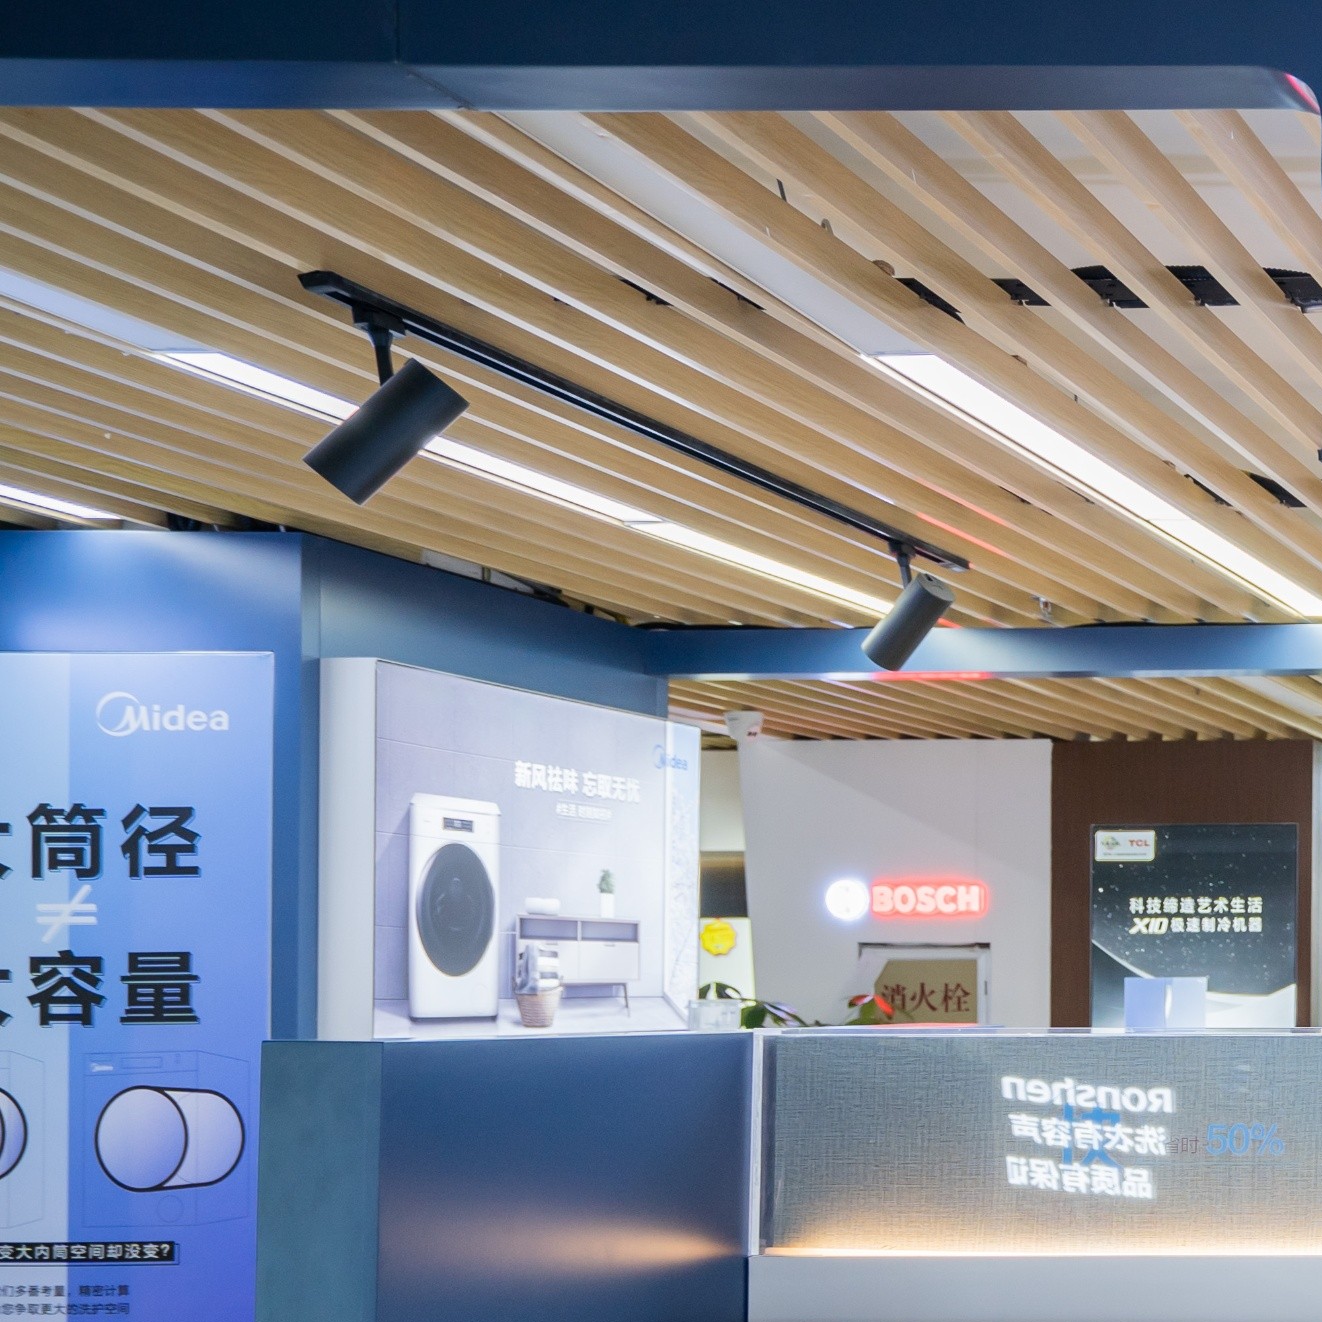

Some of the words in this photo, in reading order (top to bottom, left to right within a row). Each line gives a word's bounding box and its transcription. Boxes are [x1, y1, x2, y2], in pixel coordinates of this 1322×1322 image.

[95, 691, 229, 736] Midea
[0, 803, 202, 881] 筒径
[1128, 839, 1150, 848] TCL
[871, 885, 981, 914] BOSCH
[1129, 896, 1263, 915] 科技缔造艺术生活
[1170, 917, 1263, 933] 极速制冷机器
[0, 950, 202, 1029] 容量
[881, 981, 971, 1013] 消火栓
[1205, 1122, 1285, 1157] 50%
